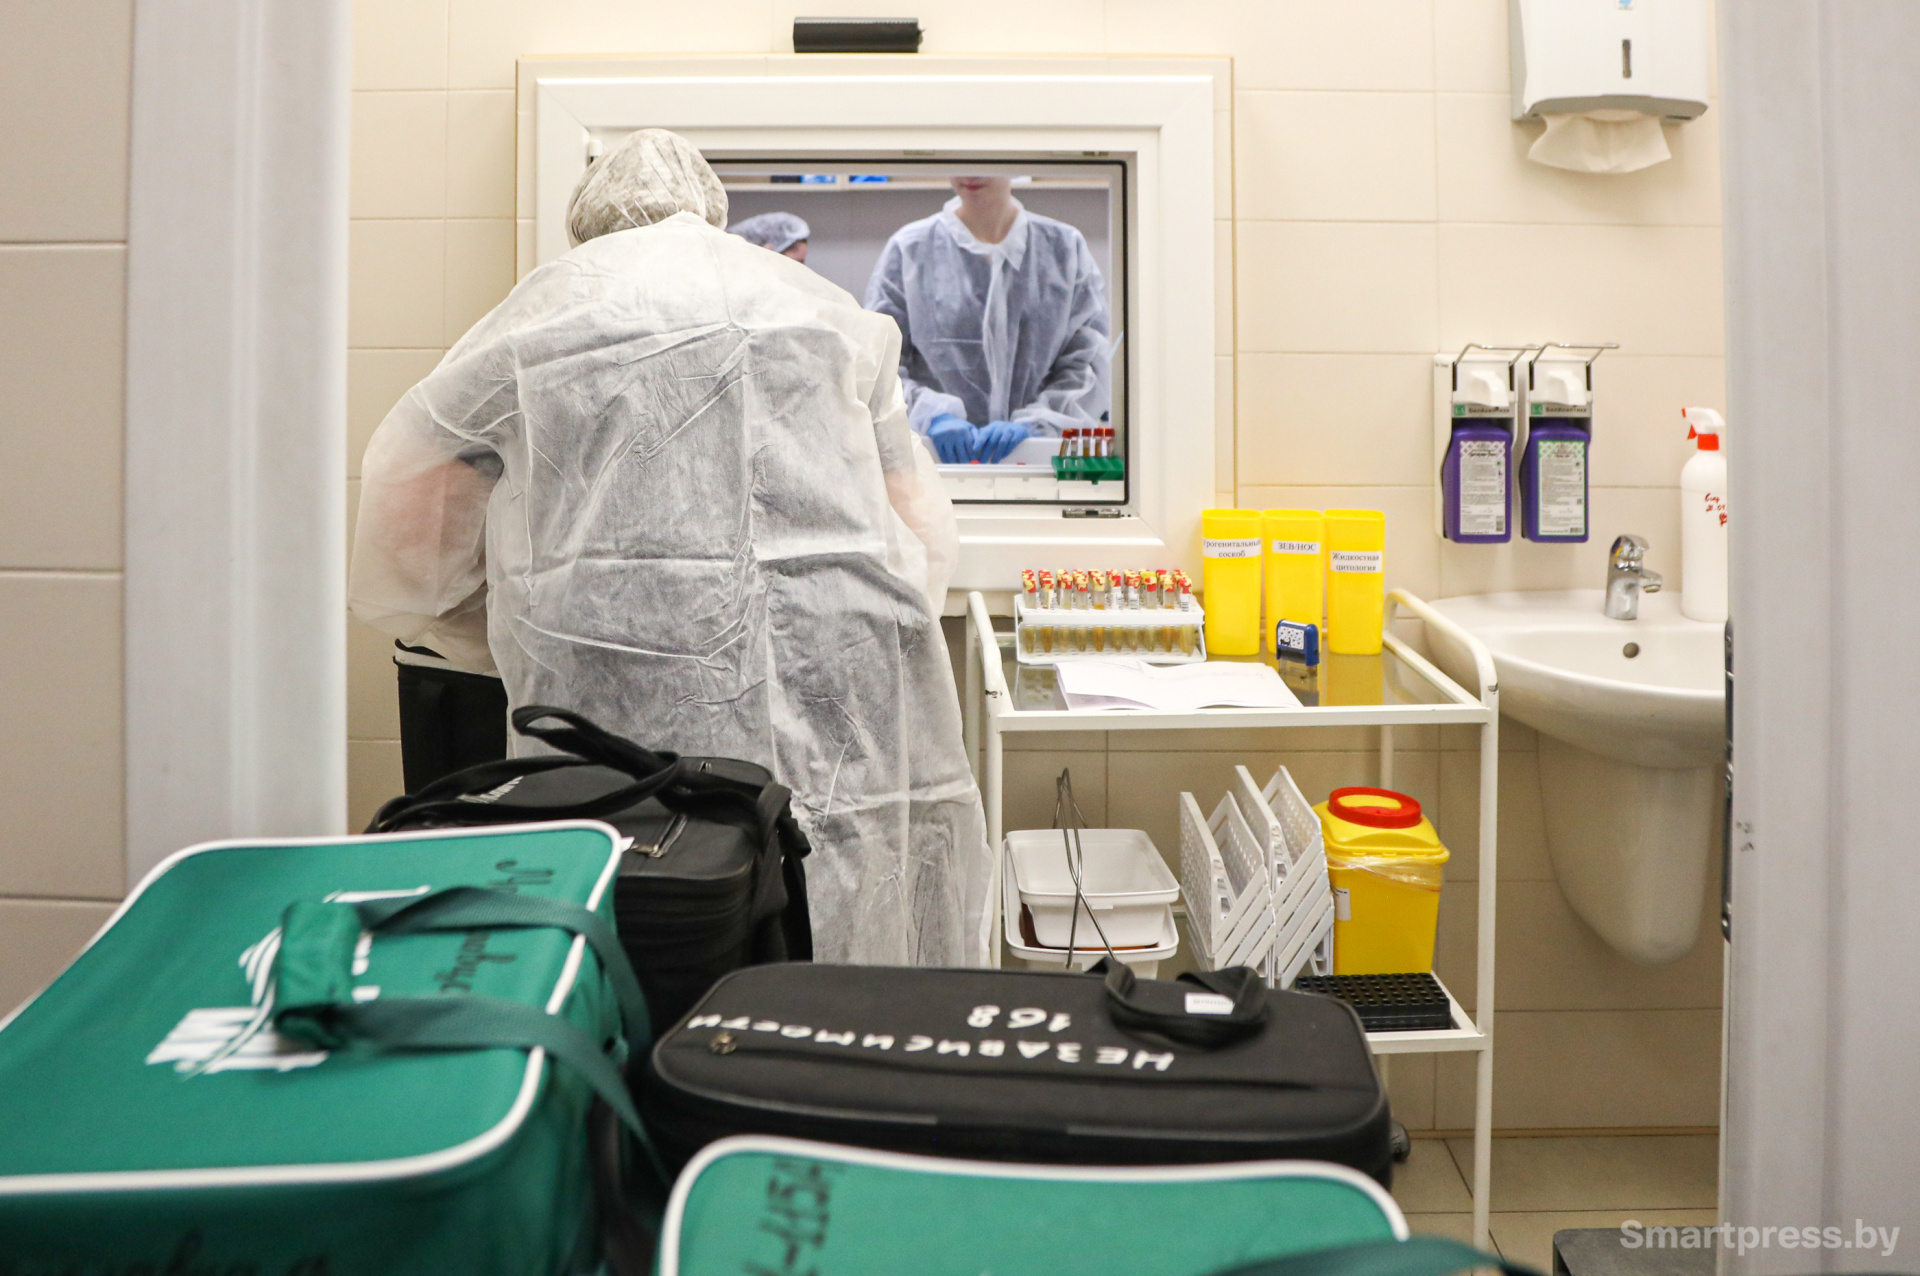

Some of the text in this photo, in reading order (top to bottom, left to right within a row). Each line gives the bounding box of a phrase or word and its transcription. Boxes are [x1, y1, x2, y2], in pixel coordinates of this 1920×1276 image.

[1277, 542, 1317, 551] ЗЕВ/НОС
[1218, 549, 1246, 558] соскоб
[1332, 552, 1380, 562] Жидкостная
[1335, 565, 1377, 573] цитология
[966, 1004, 1071, 1033] 168
